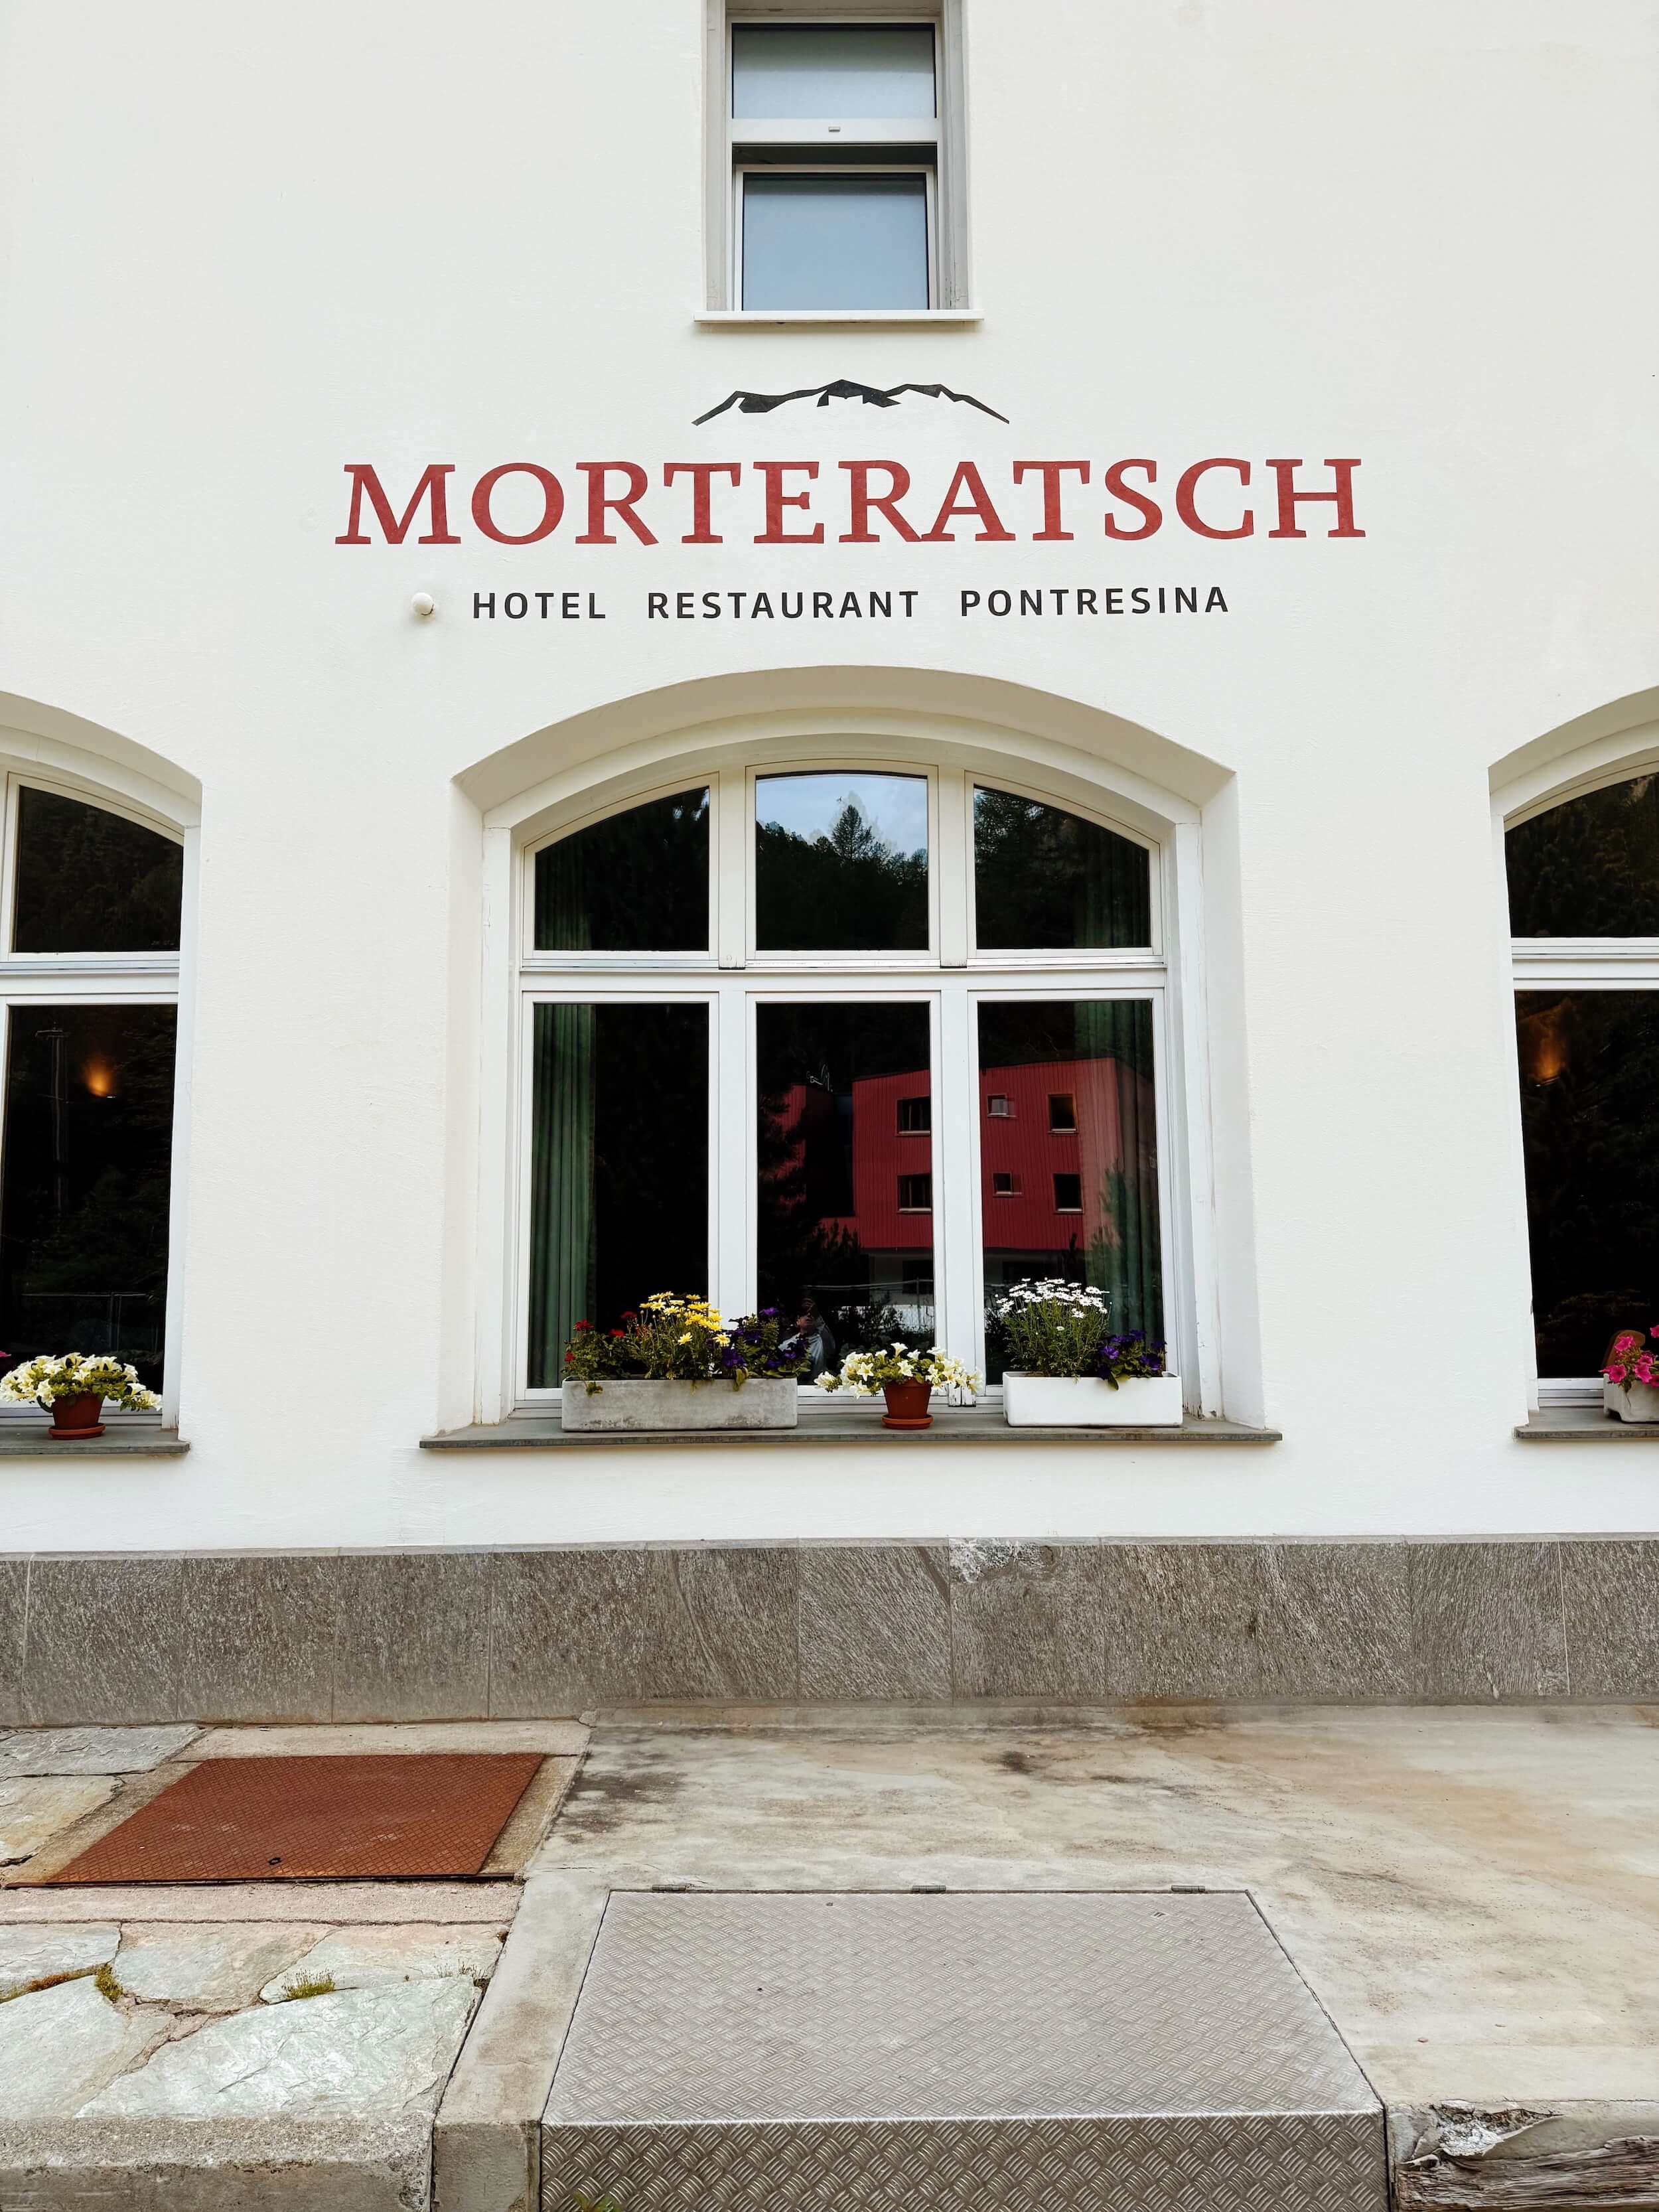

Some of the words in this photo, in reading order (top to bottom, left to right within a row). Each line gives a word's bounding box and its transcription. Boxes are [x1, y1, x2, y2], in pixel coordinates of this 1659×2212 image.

[336, 458, 1366, 545] MORTERATSCH
[472, 592, 605, 619] HOTEL
[647, 590, 918, 619] RESTAURANT
[960, 586, 1228, 617] PONTRESINA
